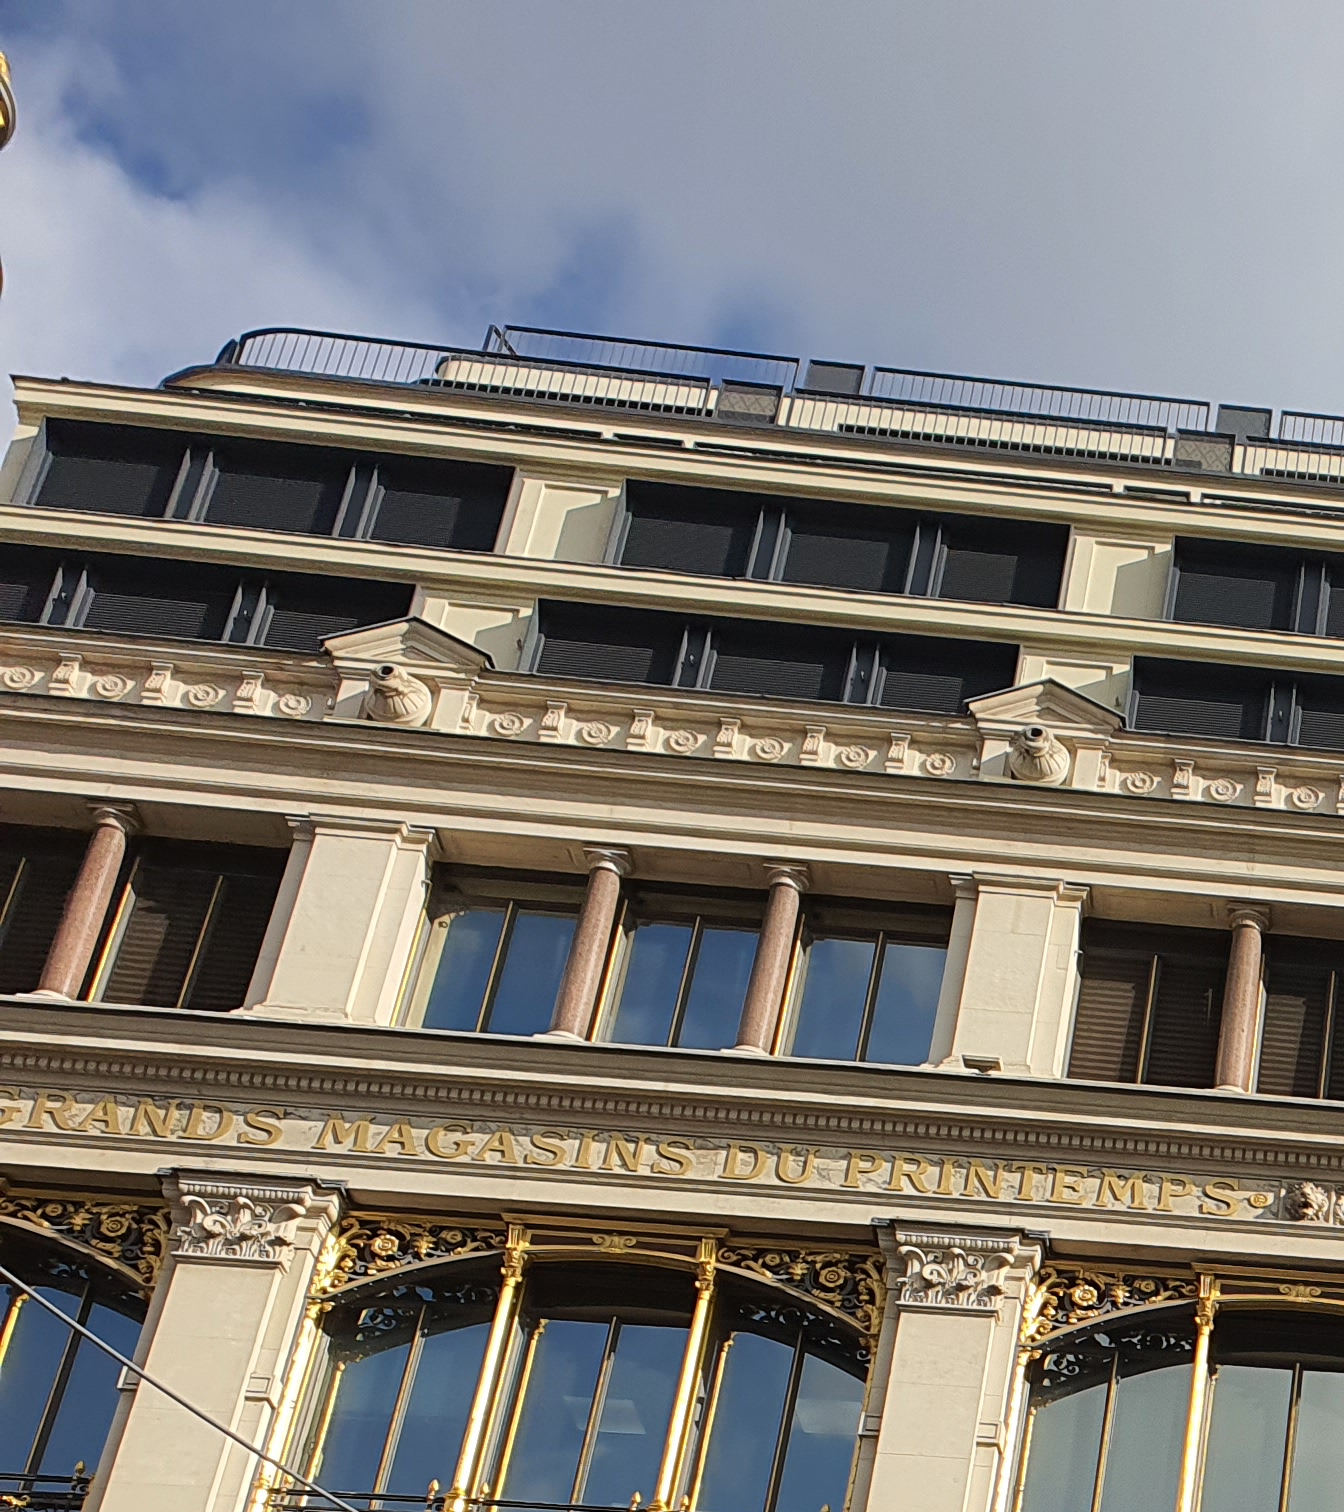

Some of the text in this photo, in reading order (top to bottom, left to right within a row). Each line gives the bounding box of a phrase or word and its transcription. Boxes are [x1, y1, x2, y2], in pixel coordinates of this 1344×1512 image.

[0, 1086, 1242, 1216] GRANDS MAGASINS DU PRINTEMPS
